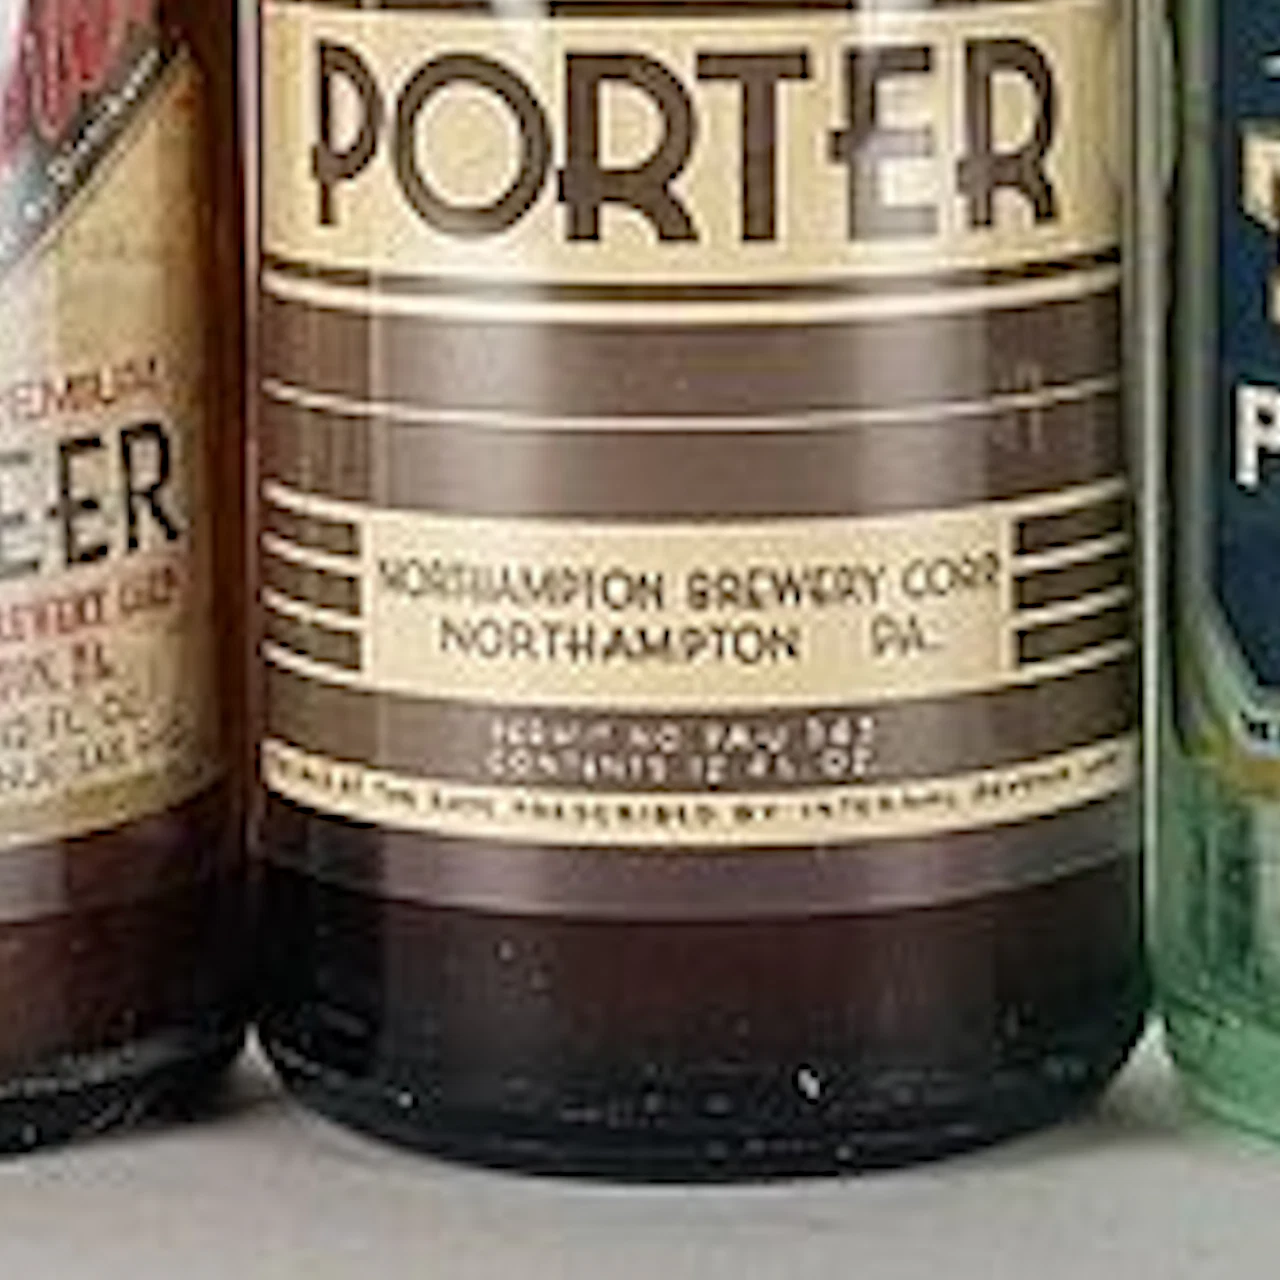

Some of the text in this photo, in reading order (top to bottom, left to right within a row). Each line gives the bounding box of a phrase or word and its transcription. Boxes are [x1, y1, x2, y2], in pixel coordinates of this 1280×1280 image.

[309, 35, 1063, 243] PORTER
[376, 555, 666, 612] NORTHAMPTON
[685, 563, 884, 612] BREWERY
[438, 613, 801, 664] NORTHAMPTON
